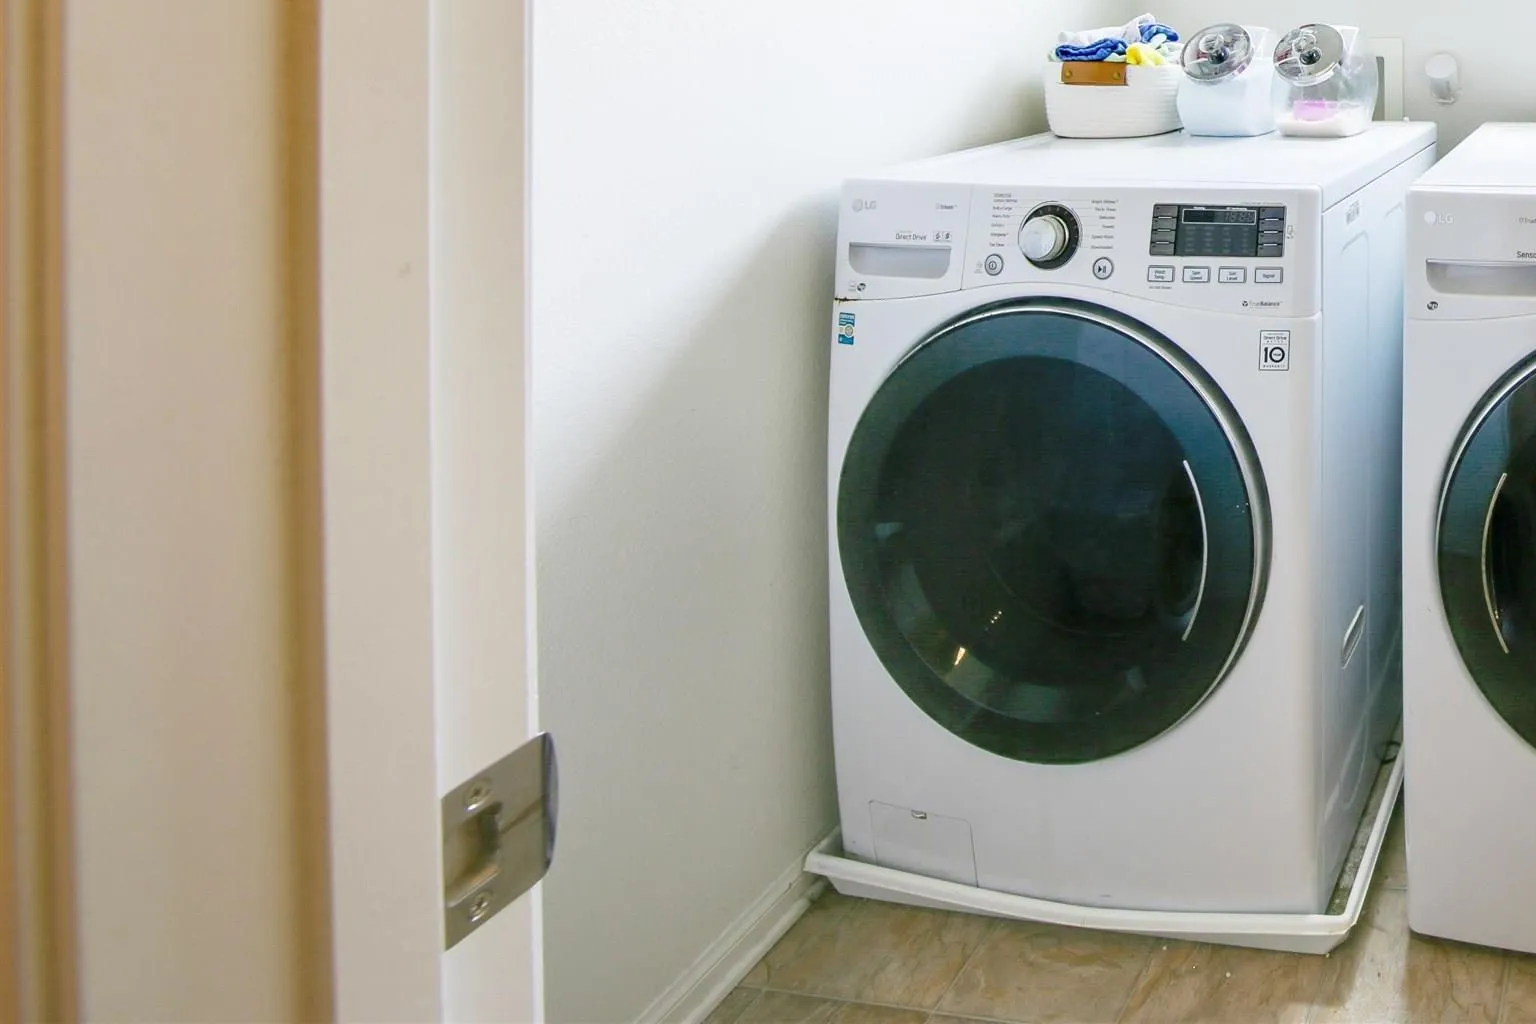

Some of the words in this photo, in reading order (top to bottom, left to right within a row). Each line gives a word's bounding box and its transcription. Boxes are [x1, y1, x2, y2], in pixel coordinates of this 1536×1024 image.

[864, 200, 877, 210] LG
[1438, 214, 1454, 224] LG
[1264, 346, 1285, 363] 10
